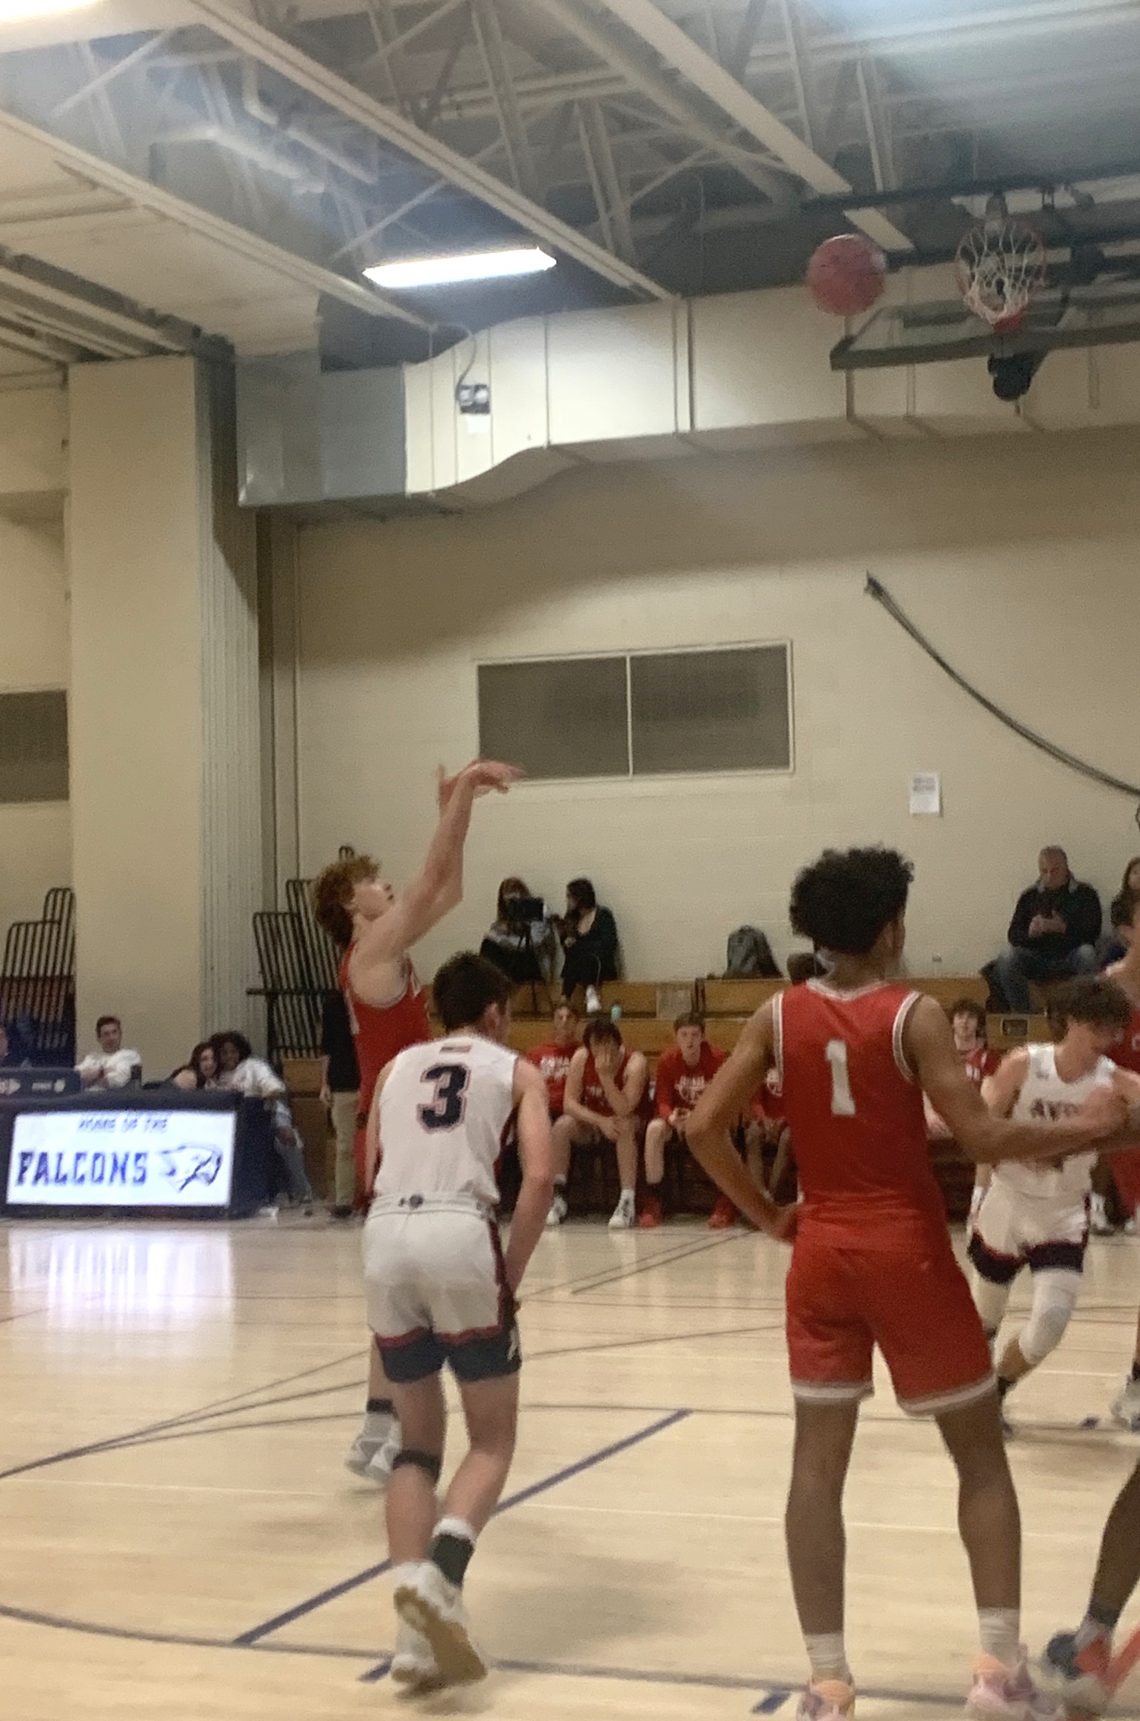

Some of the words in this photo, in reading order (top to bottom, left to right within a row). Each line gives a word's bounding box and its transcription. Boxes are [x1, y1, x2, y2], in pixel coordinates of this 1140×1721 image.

[416, 1062, 472, 1135] 3
[826, 1039, 856, 1117] 1
[16, 1151, 148, 1186] FALCONS
